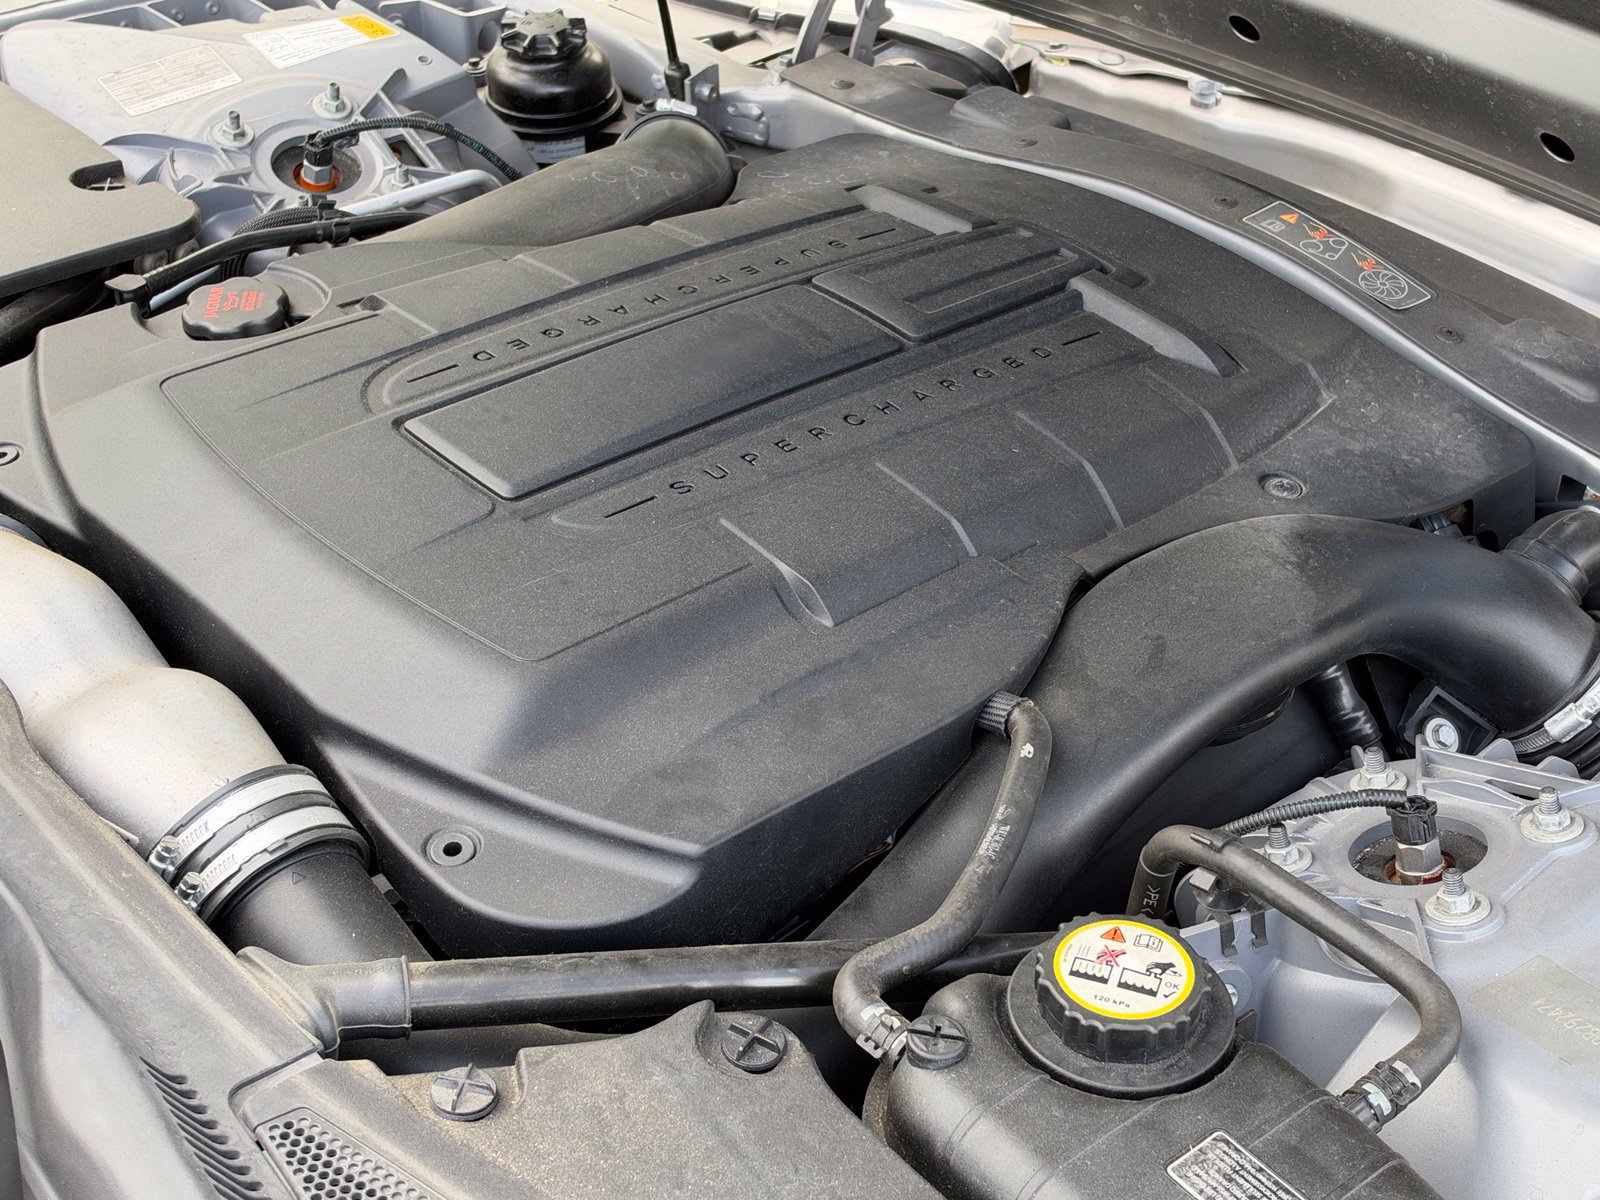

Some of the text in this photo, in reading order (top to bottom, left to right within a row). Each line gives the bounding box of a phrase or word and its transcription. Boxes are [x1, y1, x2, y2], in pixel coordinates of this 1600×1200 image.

[203, 286, 224, 318] JAGUAR
[473, 238, 849, 363] SUPERCHARGED
[669, 346, 1056, 495] SUPERCHARGED
[1093, 994, 1131, 1009] 120 kPa
[1164, 981, 1180, 990] OK
